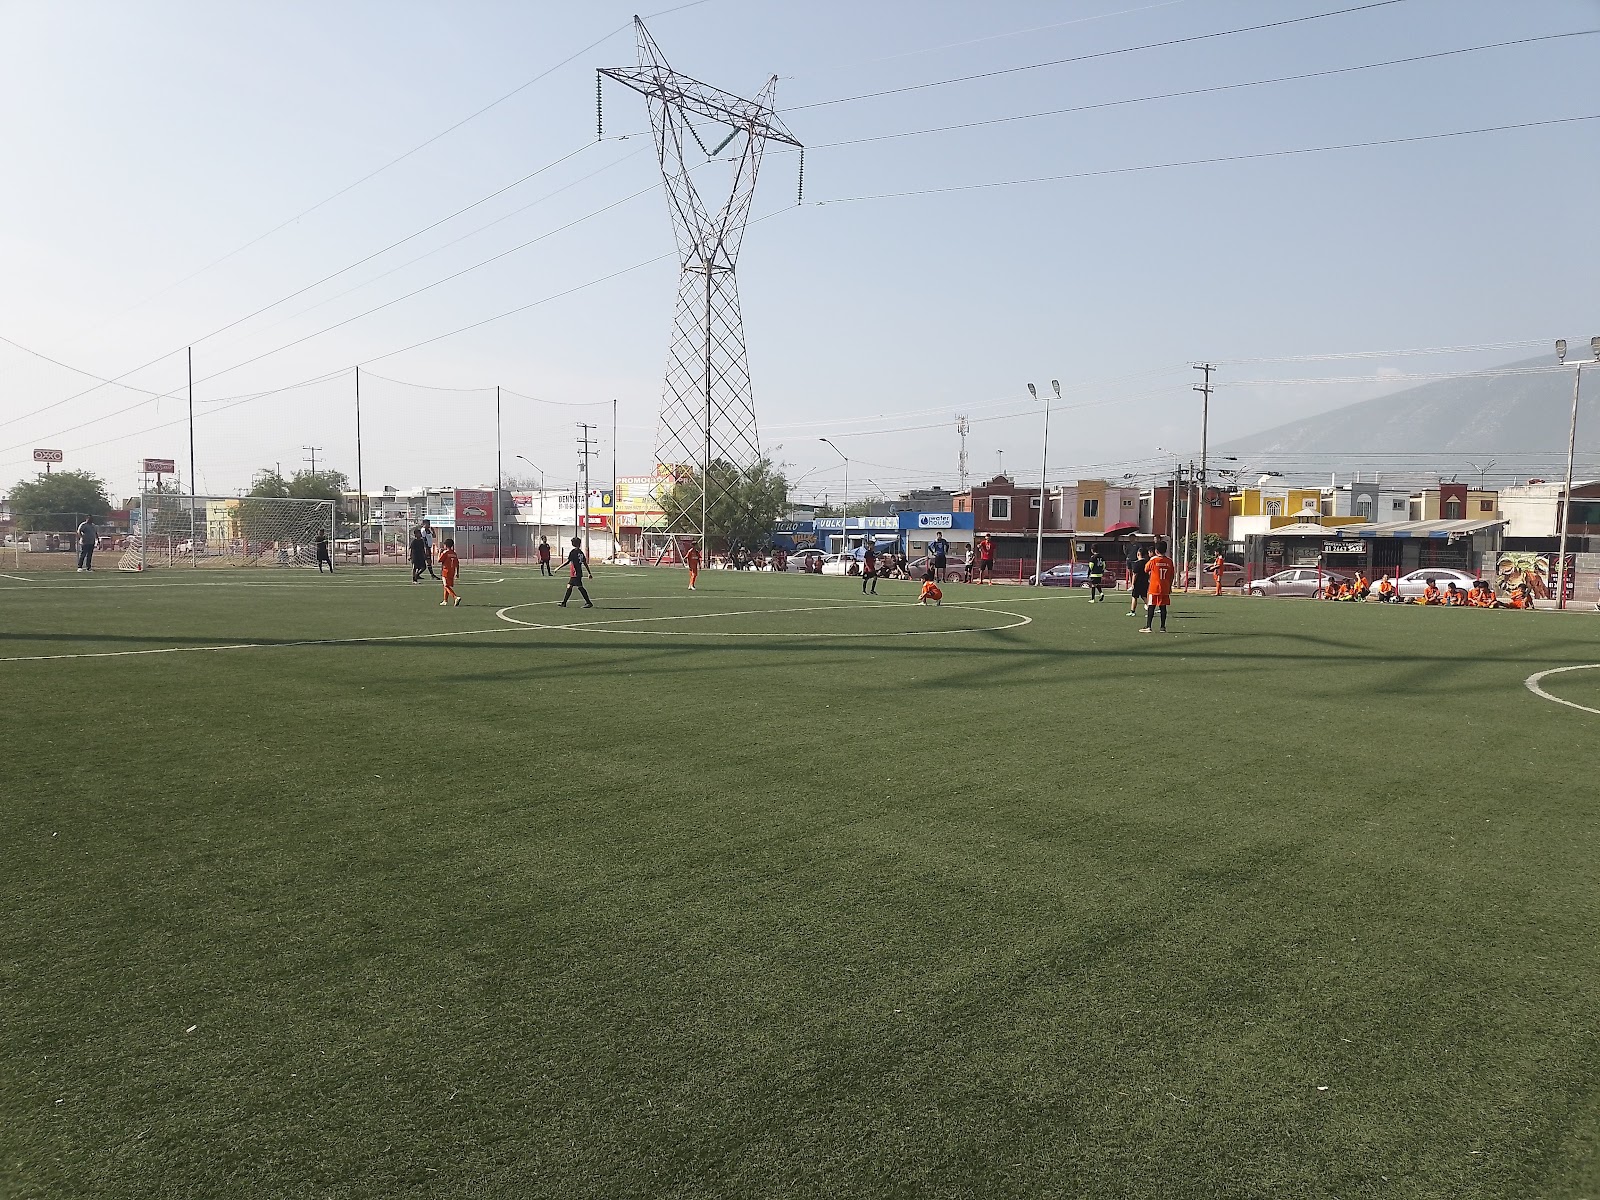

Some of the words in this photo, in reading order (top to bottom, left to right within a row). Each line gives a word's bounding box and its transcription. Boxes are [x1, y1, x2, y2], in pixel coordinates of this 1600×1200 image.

[35, 452, 61, 460] OXXO
[868, 518, 898, 527] VULKA
[1159, 568, 1168, 580] 17
